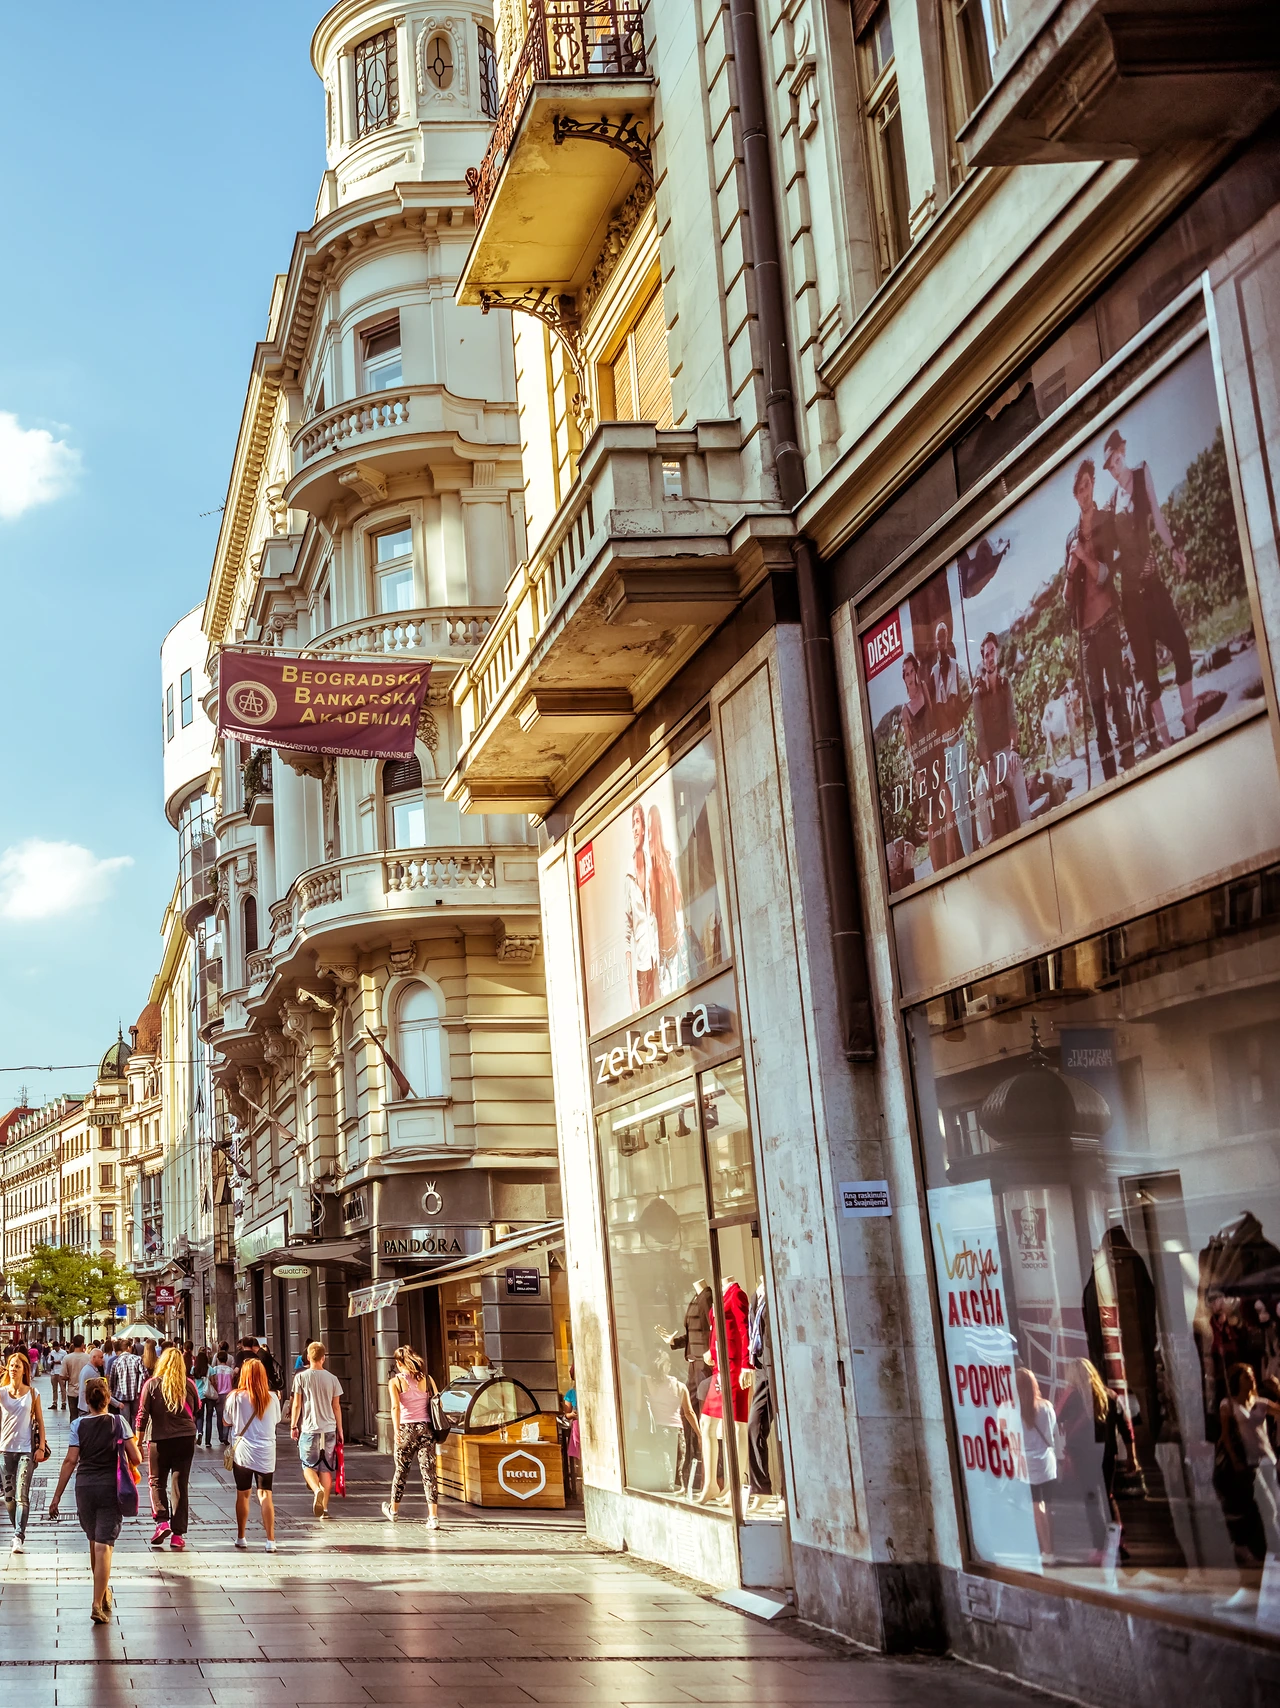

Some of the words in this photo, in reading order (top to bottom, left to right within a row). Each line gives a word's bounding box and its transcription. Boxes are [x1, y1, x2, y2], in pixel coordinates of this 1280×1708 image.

[867, 621, 900, 669] DIESEL
[281, 665, 421, 686] BEOGRADSKA
[294, 686, 416, 706] BANKARSKA
[299, 707, 412, 726] AKADEMIJA
[320, 746, 369, 757] OSIGURANJE
[374, 750, 413, 759] FINANSIJE
[892, 743, 967, 815] DIESEL
[927, 751, 1008, 827] ISLAND
[578, 850, 594, 879] DIESEL
[590, 947, 618, 982] DIESEL
[594, 1002, 711, 1085] zekstra
[383, 1238, 462, 1254] PANDORA
[948, 1288, 1005, 1328] AKCIJA
[954, 1364, 1015, 1408] POPUST
[962, 1435, 986, 1472] DO
[506, 1470, 538, 1479] nora
